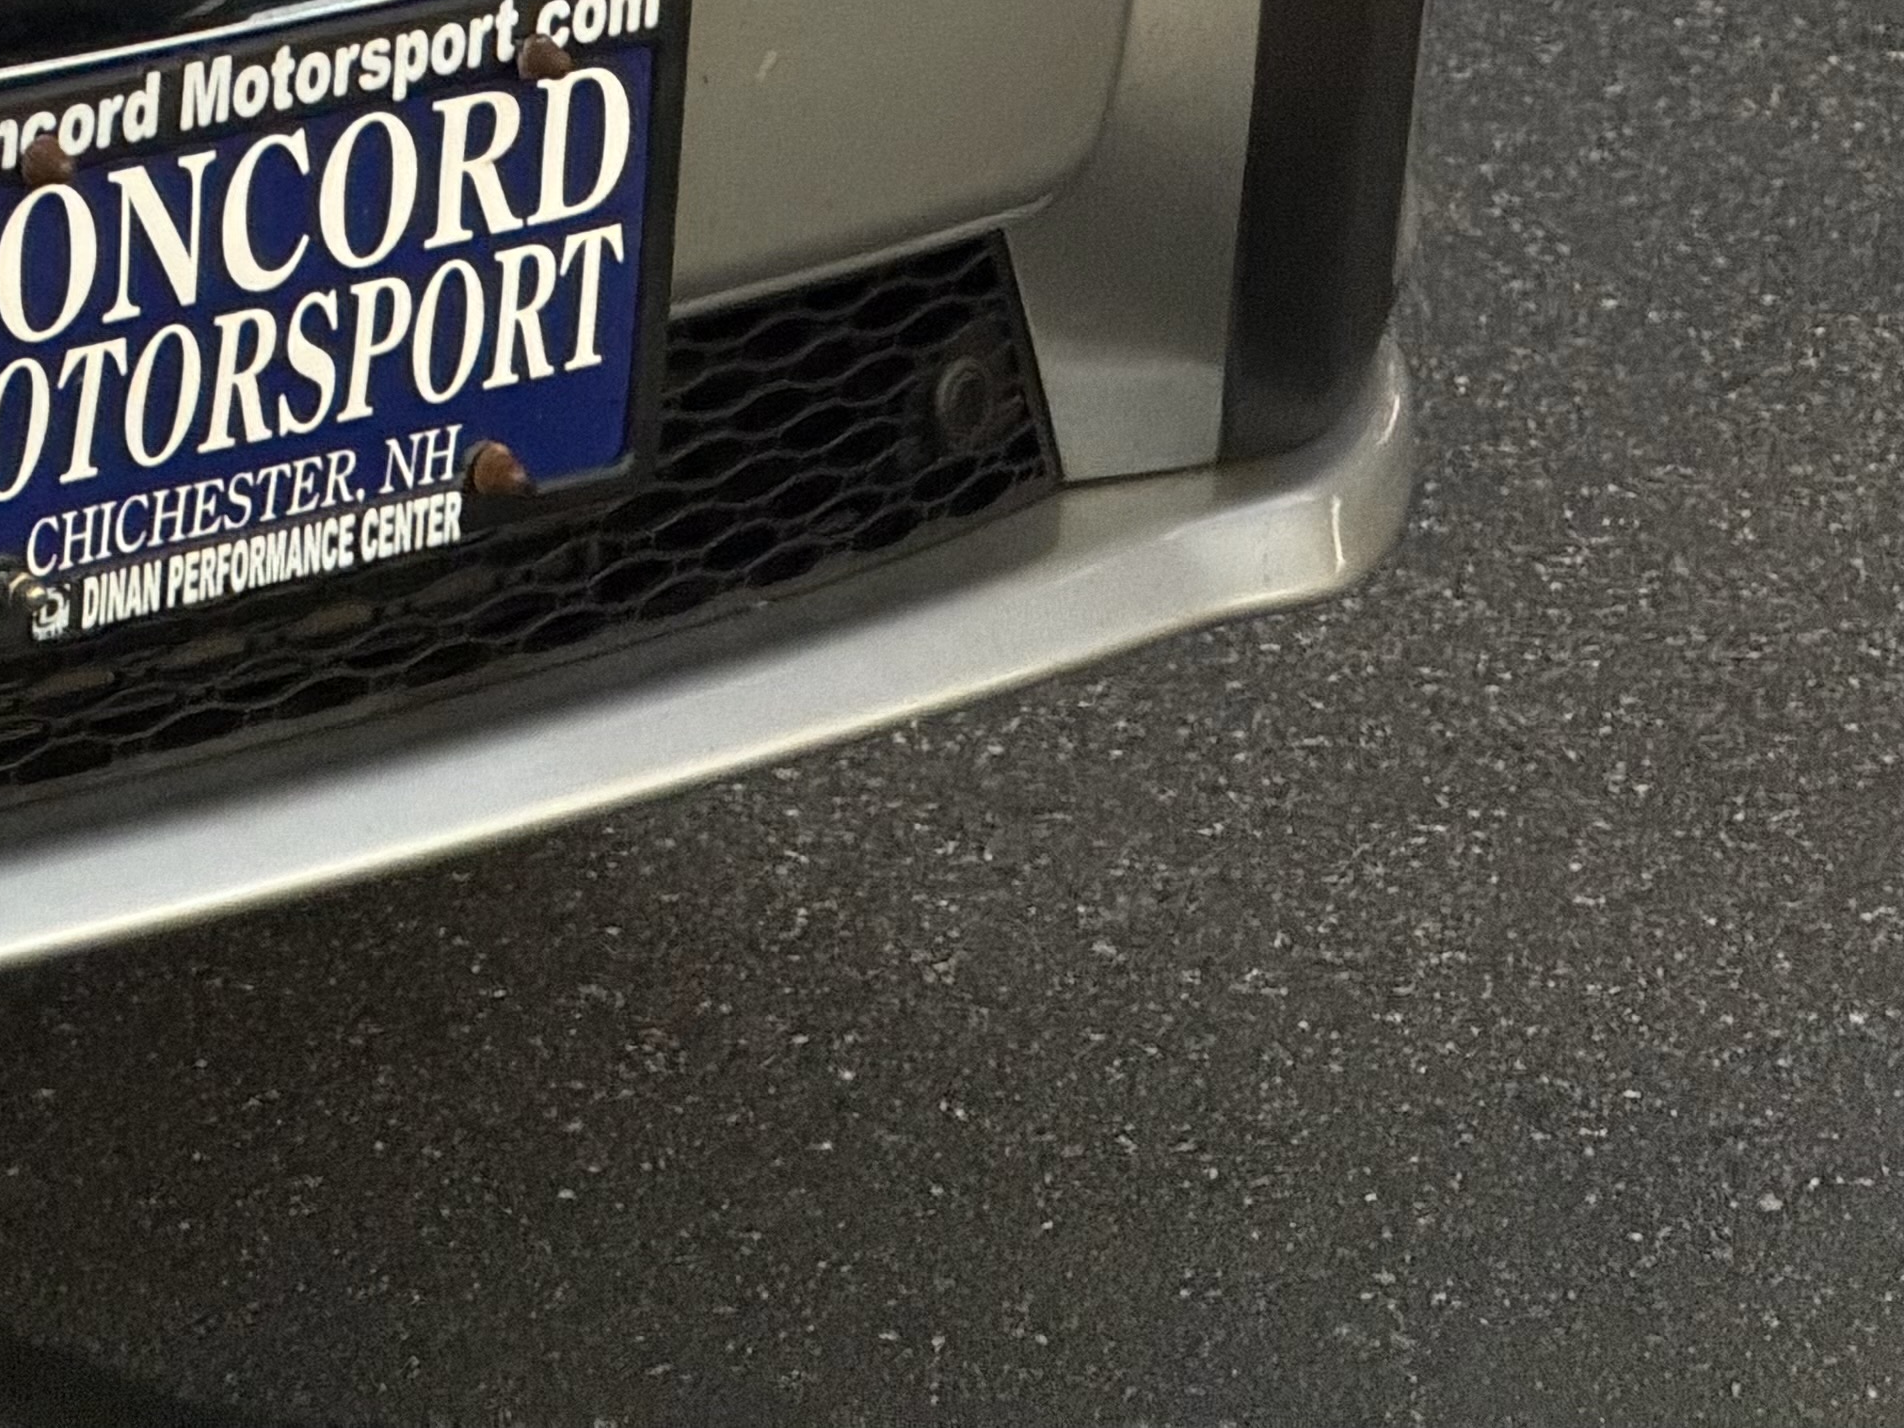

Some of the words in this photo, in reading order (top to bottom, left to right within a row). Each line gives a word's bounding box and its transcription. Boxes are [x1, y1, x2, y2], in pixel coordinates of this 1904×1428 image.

[26, 449, 366, 577] CHICHESTER,
[378, 424, 463, 494] NH
[81, 550, 162, 629] DINAN
[166, 512, 356, 609] PERFORMANCE
[360, 490, 463, 562] CENTER
